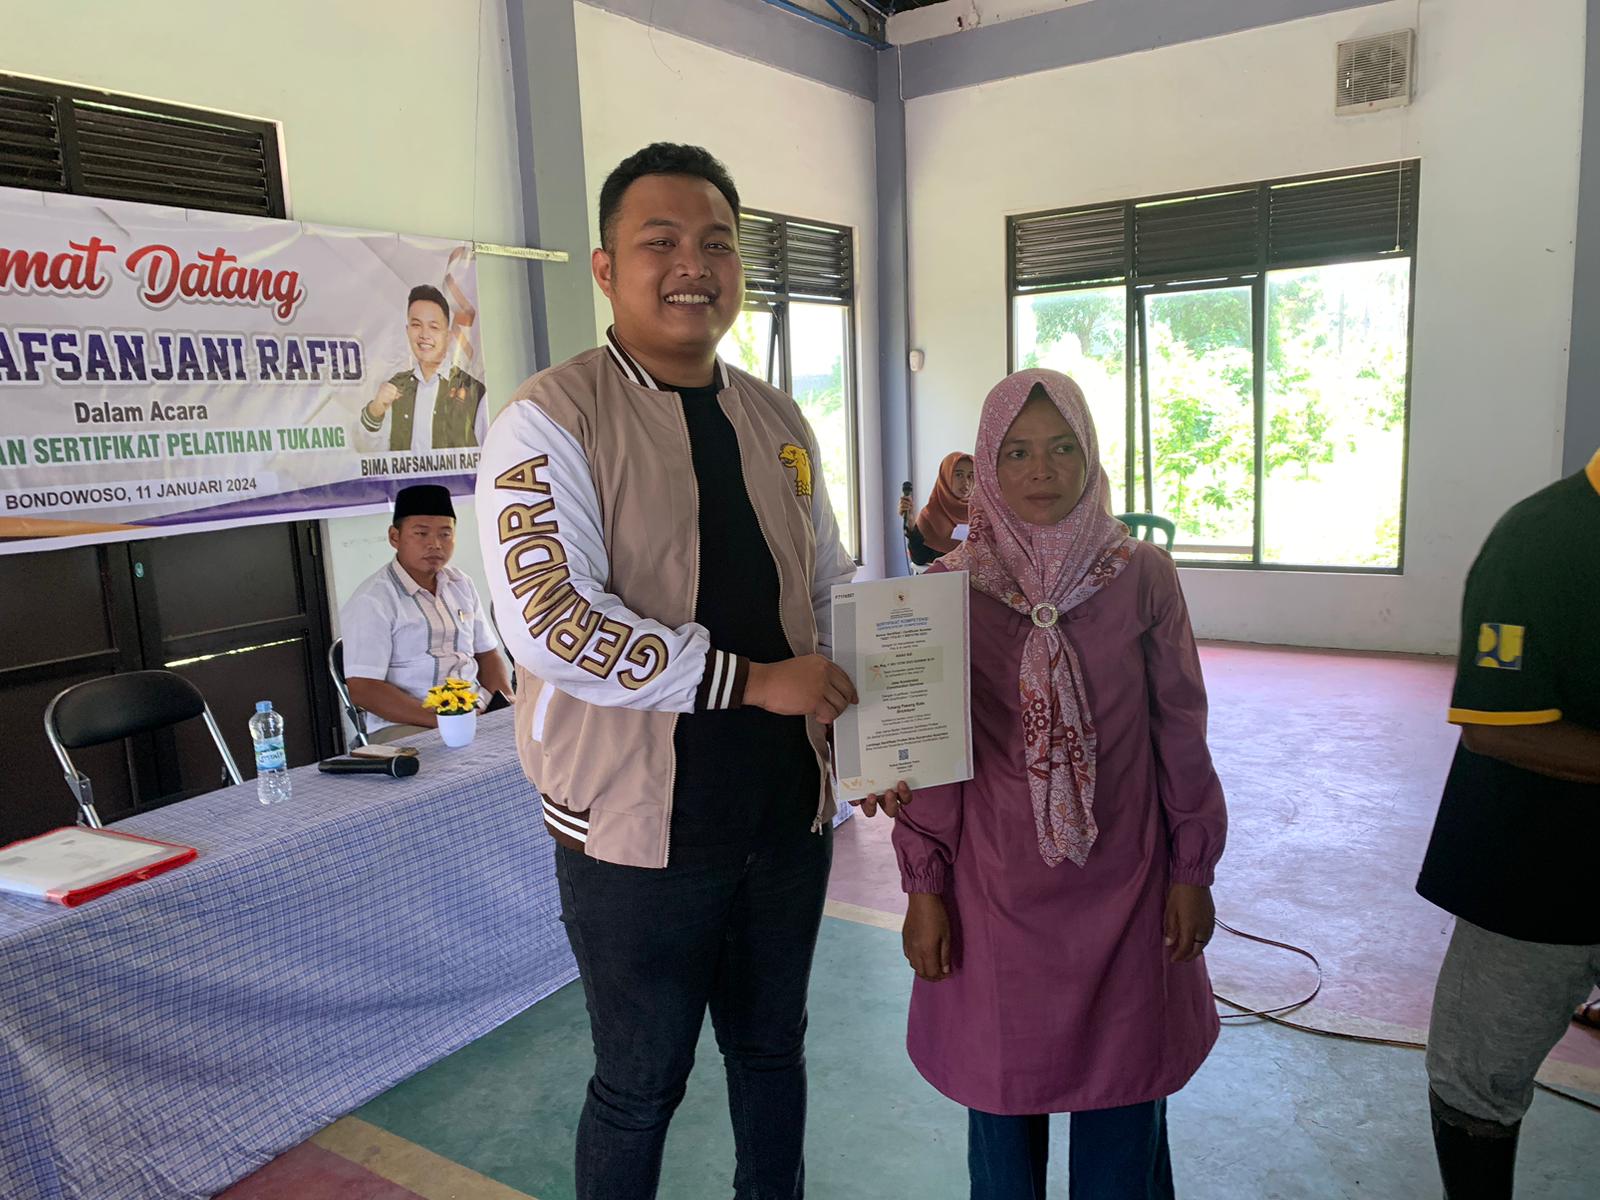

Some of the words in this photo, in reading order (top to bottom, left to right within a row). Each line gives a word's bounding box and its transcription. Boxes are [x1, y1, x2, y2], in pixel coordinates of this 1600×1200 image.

[0, 236, 117, 291] mat
[125, 243, 304, 320] Datang
[0, 331, 246, 381] AFSANJANI
[259, 338, 363, 381] RAFID
[74, 401, 144, 424] Dalam
[150, 401, 208, 422] Acara
[33, 434, 161, 464] SERTIFIKAT
[166, 428, 272, 458] PELATIHAN
[276, 425, 345, 451] TUKANG
[361, 457, 389, 476] BIMA
[391, 453, 457, 475] RAFSANJANI
[5, 487, 131, 510] BONDOWOSO,
[136, 485, 151, 499] 11
[156, 479, 222, 498] JANUARI
[226, 477, 257, 493] 2024
[495, 454, 669, 691] GERINDRA
